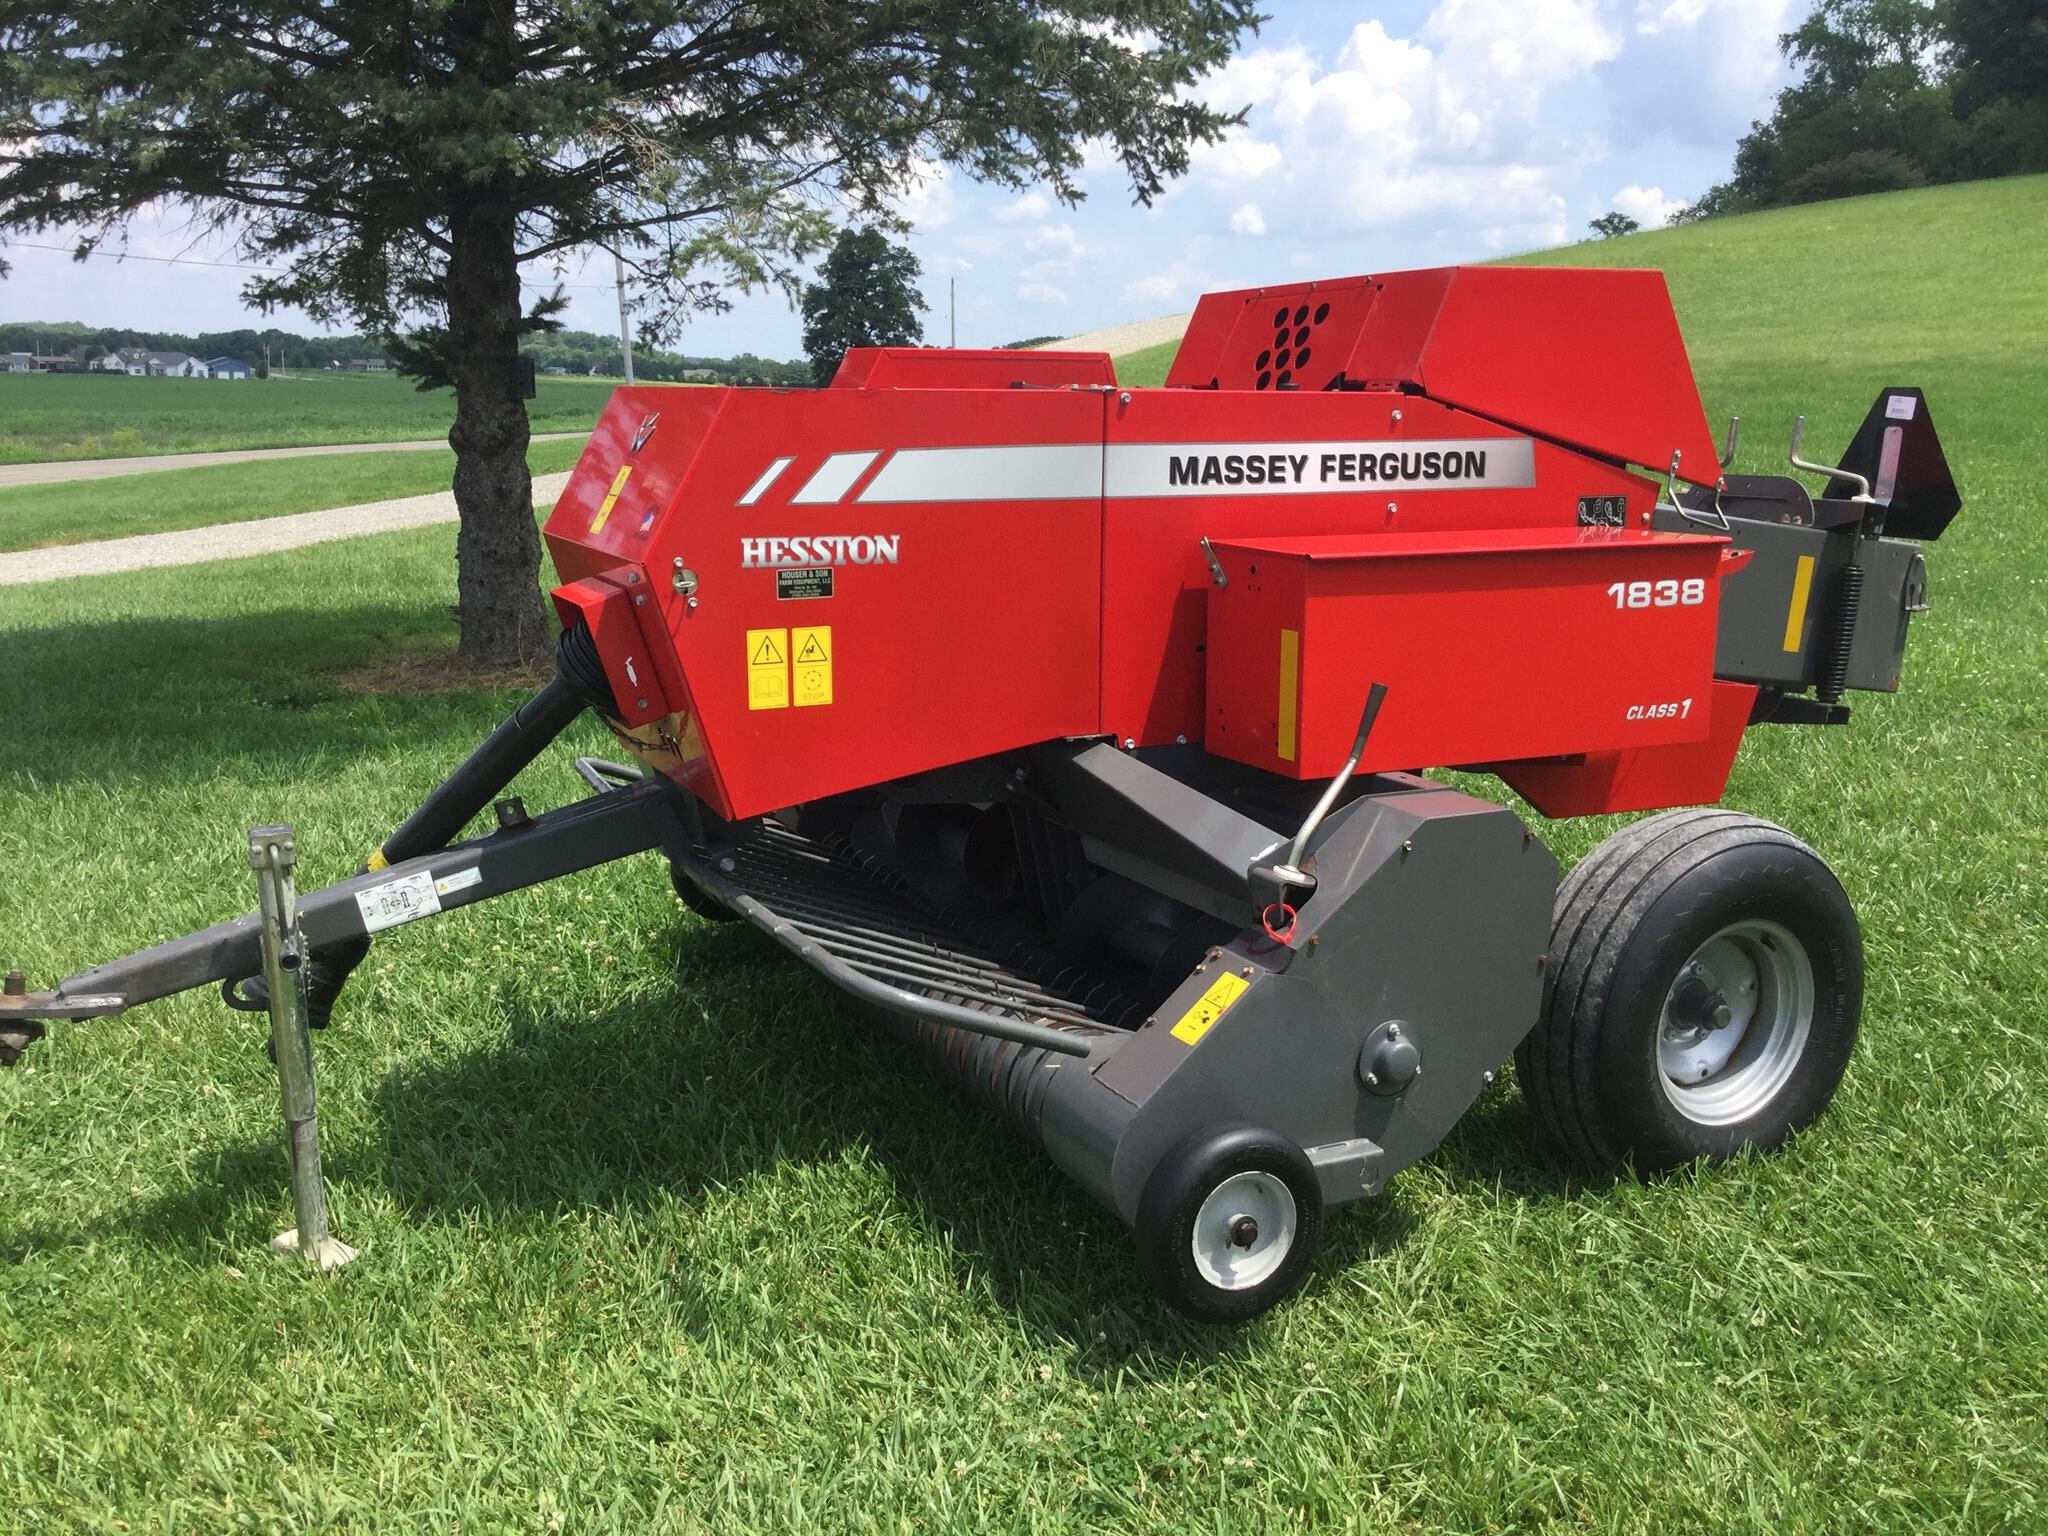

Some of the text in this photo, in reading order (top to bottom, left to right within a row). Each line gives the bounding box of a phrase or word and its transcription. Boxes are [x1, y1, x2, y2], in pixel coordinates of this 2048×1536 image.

[1169, 451, 1486, 485] MASSEY FERGUSON
[741, 535, 900, 568] HESSTON
[782, 571, 807, 579] HOUSER
[809, 570, 814, 578] &
[1607, 578, 1705, 609] 1838
[1626, 698, 1693, 720] CLASS 1
